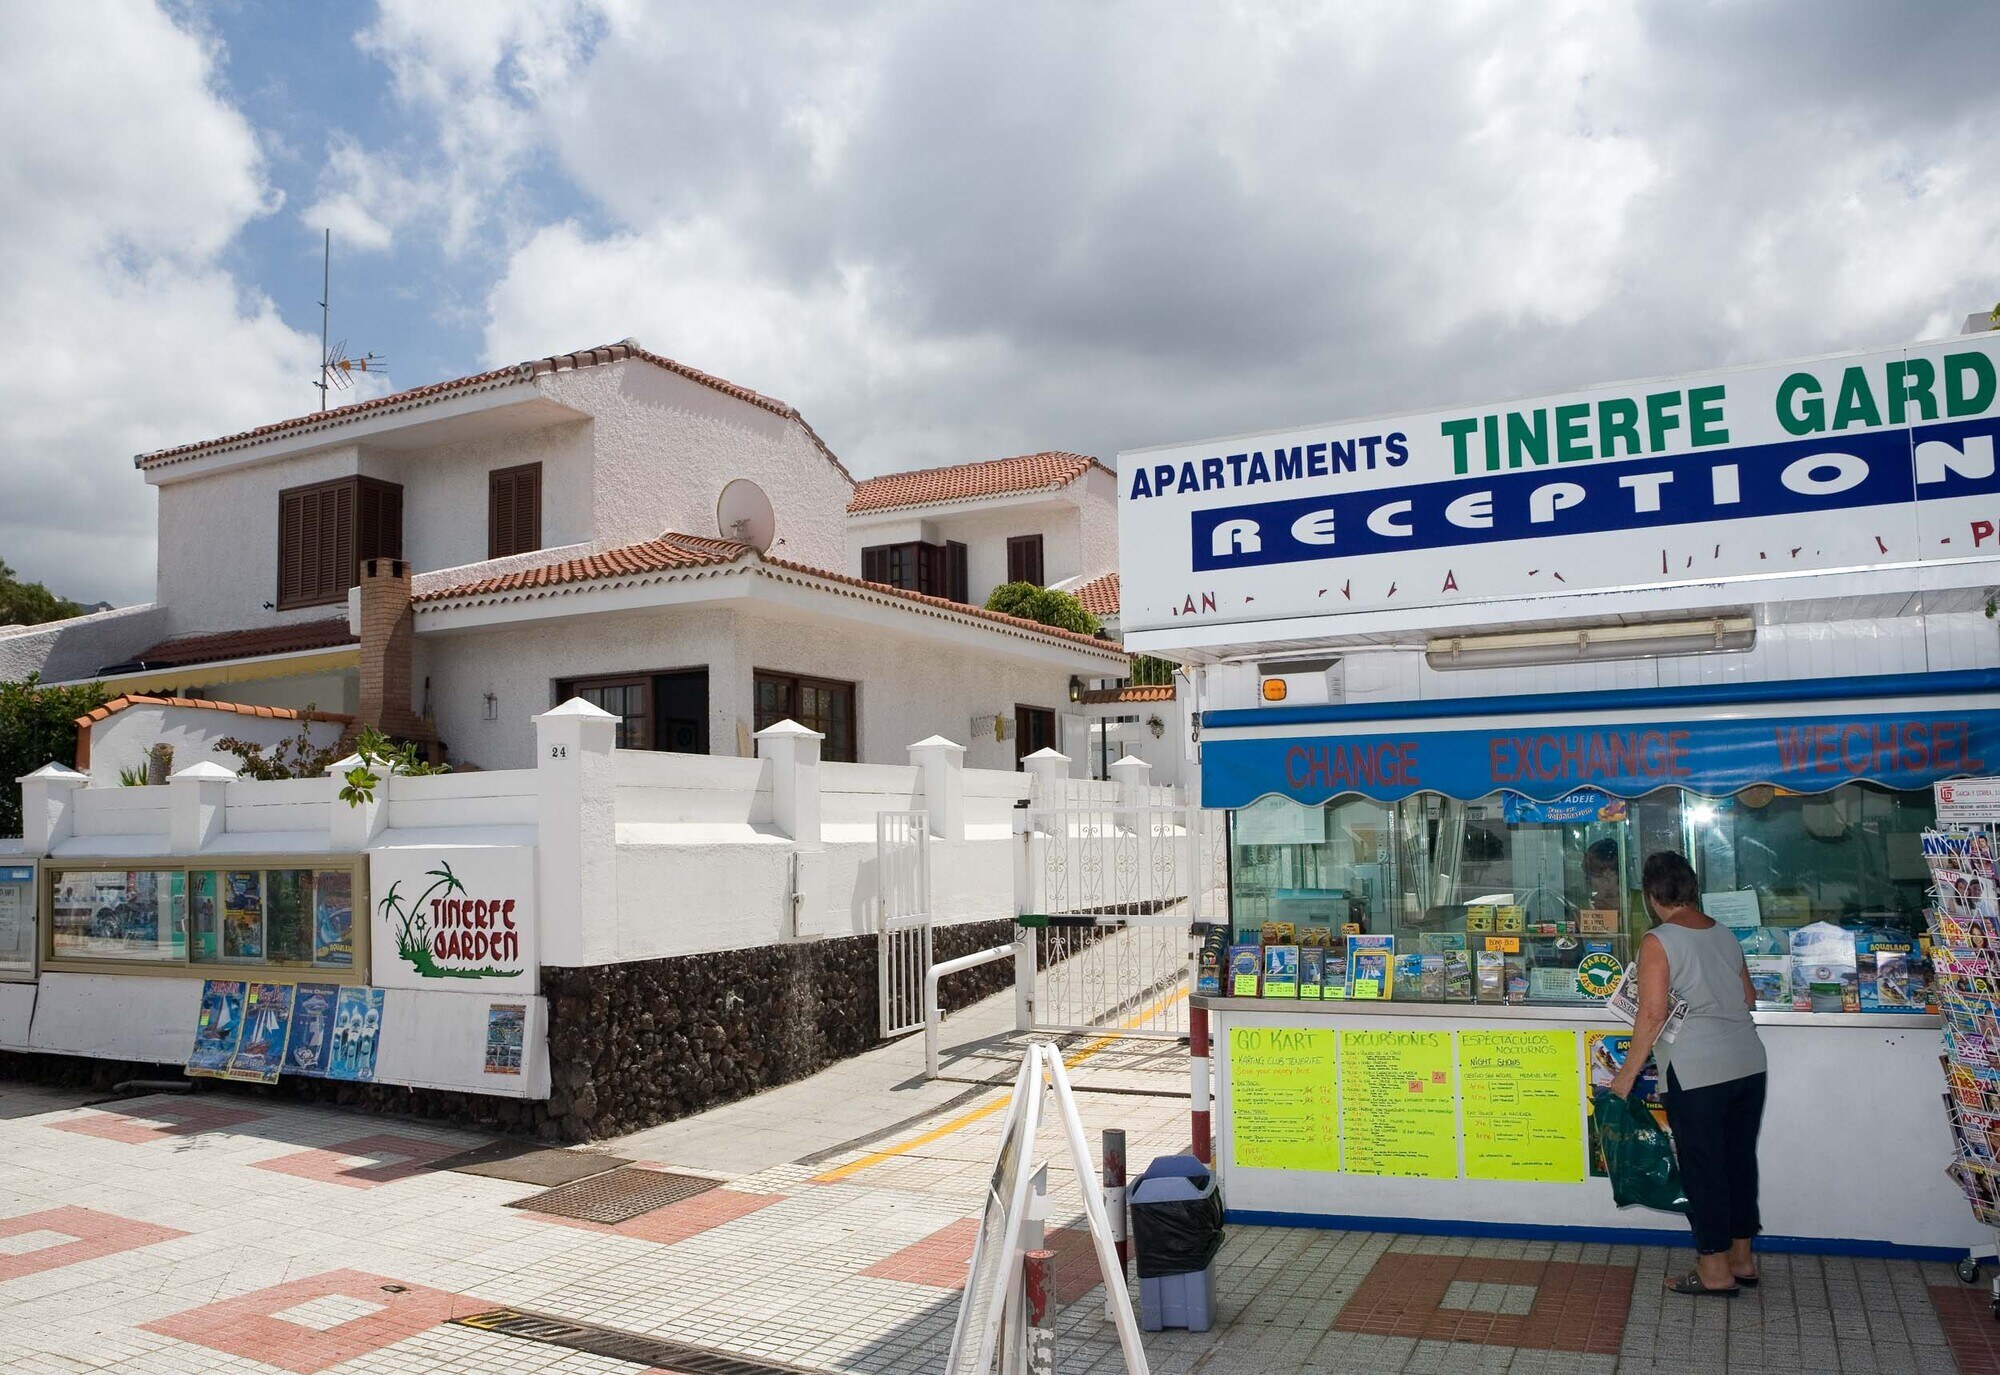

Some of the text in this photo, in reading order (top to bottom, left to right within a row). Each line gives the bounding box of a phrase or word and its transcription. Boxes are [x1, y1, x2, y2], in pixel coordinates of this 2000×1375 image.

[1130, 351, 1997, 500] APARTAMENTS TINERFE GARD
[1212, 434, 1995, 556] RECEPTION
[552, 746, 567, 758] 24
[1285, 722, 1985, 790] CHANGE EXCHANGE WECHSEL
[430, 898, 516, 930] TINERFE
[434, 930, 519, 962] GARDEN
[1870, 943, 1911, 952] AQUALAND
[1582, 955, 1620, 972] PARQUE
[1581, 975, 1621, 995] LAS AGUILAS
[1237, 1029, 1319, 1052] GO KART
[1344, 1032, 1439, 1048] EXCURSIONES
[1496, 1045, 1557, 1055] NOCTURNOS
[1497, 1058, 1521, 1067] SHOWS
